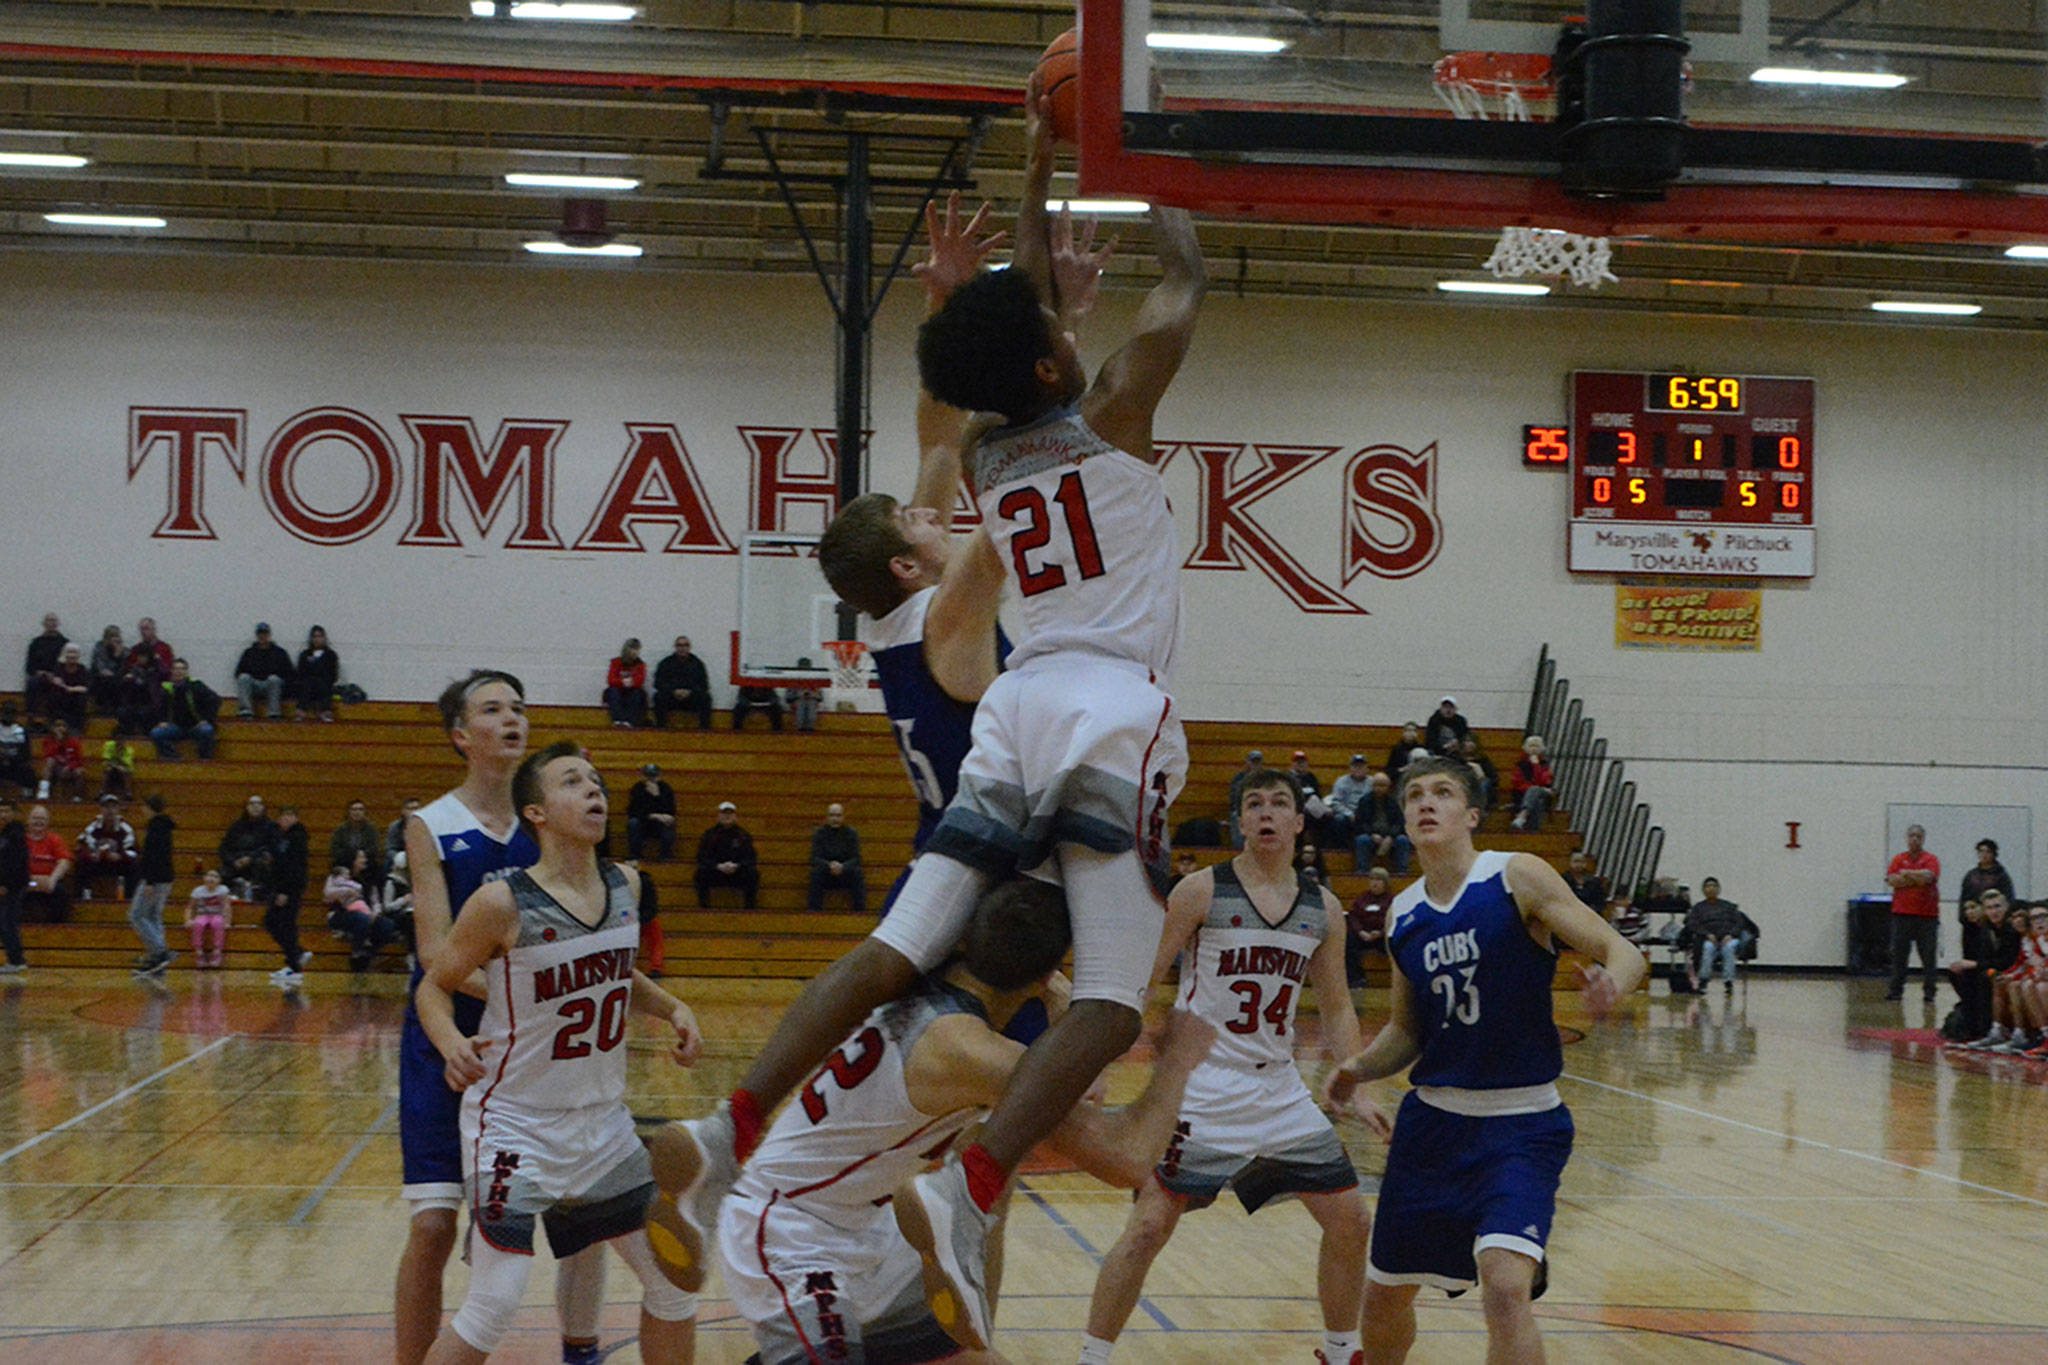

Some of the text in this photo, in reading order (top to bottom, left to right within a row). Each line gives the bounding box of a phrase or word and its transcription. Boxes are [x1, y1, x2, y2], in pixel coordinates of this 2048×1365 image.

[1669, 377, 1738, 409] 6:59
[1528, 428, 1568, 461] 25
[1617, 431, 1636, 463] 3
[1694, 439, 1702, 461] 1
[1779, 436, 1799, 469] 0
[1593, 478, 1611, 502] 0
[1629, 478, 1646, 504] 5
[1739, 482, 1757, 507] 5
[1782, 483, 1799, 508] 0
[127, 406, 1443, 615] TOMAHKS
[998, 470, 1106, 597] 21
[1595, 530, 1792, 551] Marysville Pilchuck
[1631, 554, 1759, 572] TOMAHAWKS
[1423, 928, 1481, 972] CUBS
[551, 986, 628, 1060] 20
[1225, 980, 1293, 1036] 34
[486, 1151, 520, 1221] MPHS
[805, 1271, 848, 1360] MPHS
